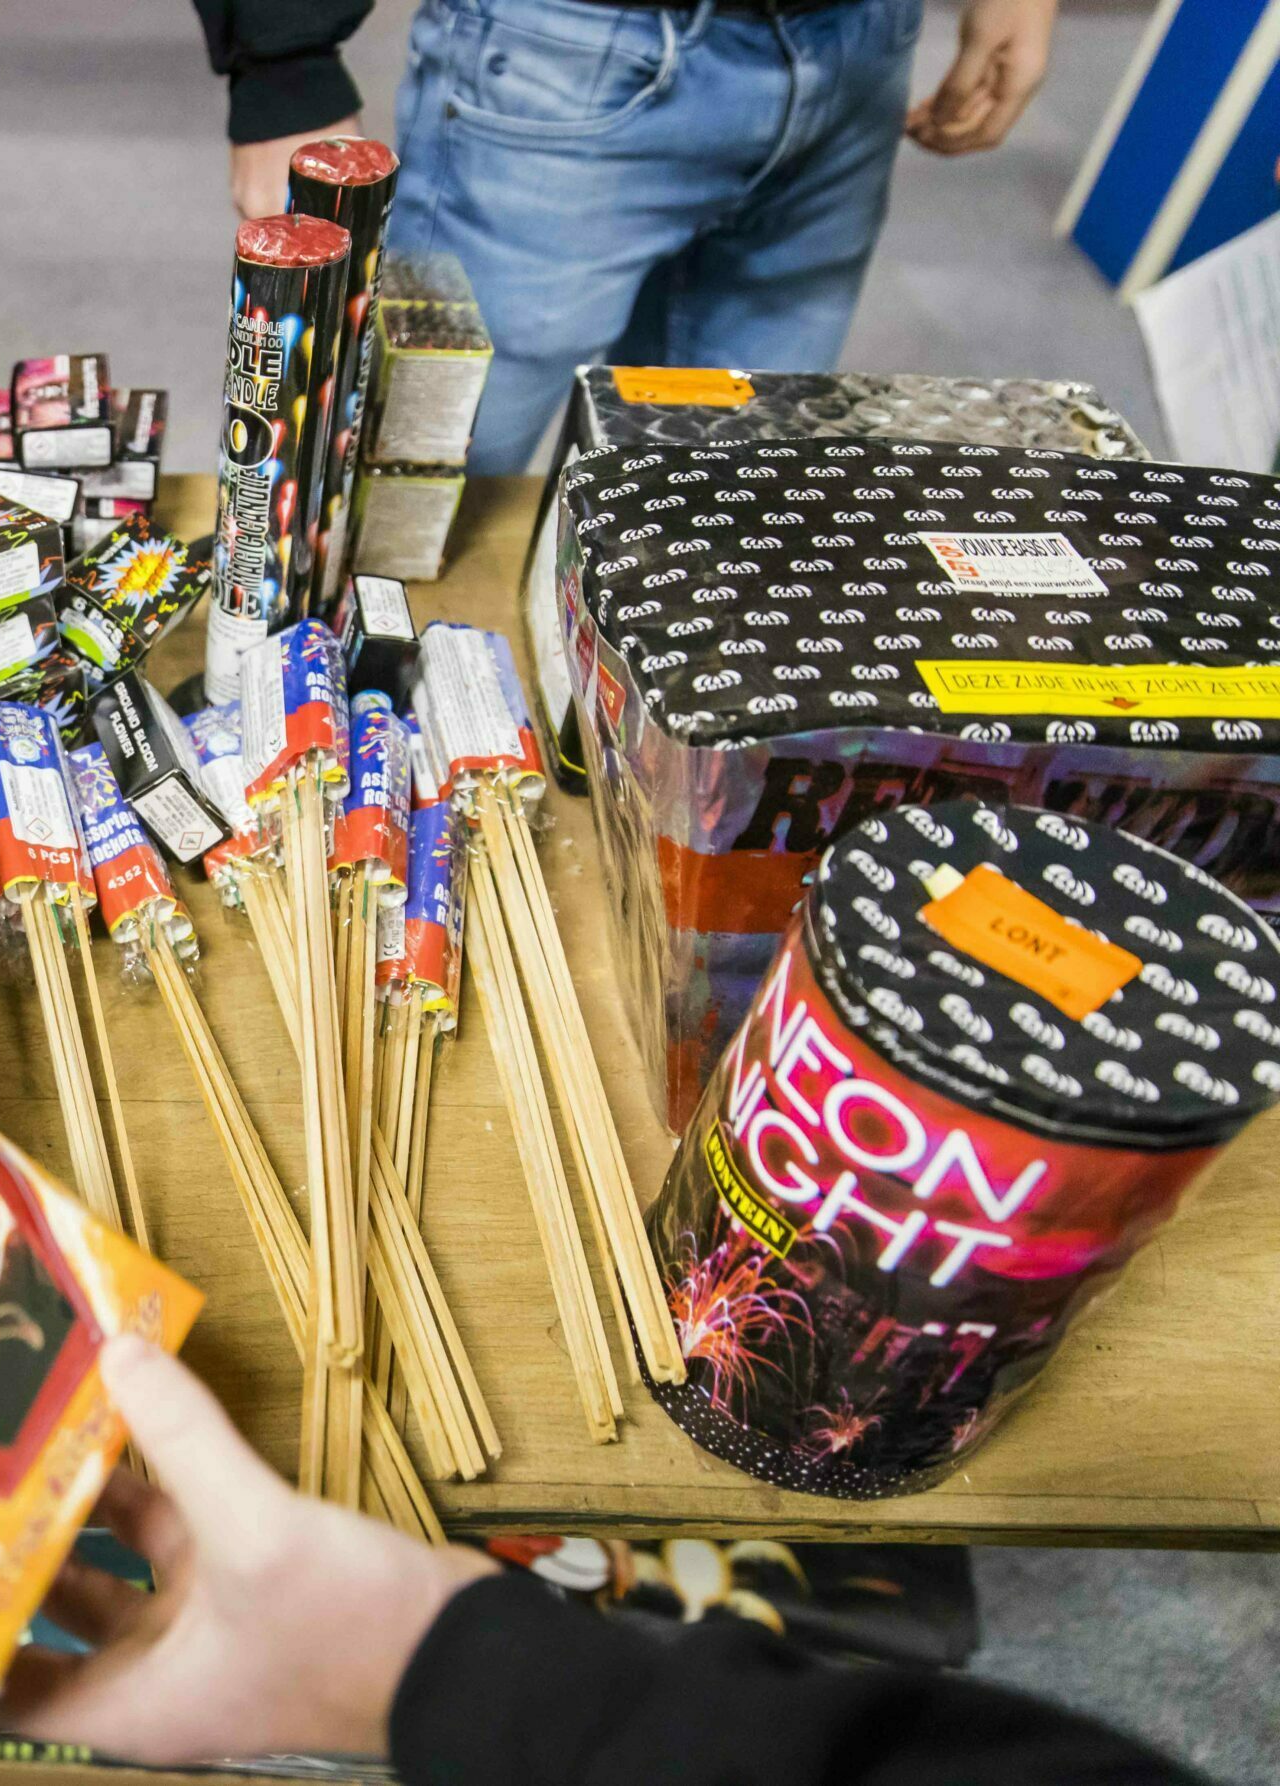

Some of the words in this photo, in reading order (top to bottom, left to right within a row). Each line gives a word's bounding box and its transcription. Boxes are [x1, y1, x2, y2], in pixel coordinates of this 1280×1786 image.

[953, 538, 996, 556] VOUW
[990, 538, 1016, 556] DE
[1010, 538, 1048, 556] BASIS
[958, 578, 988, 588] Draag
[990, 578, 1012, 588] altijd
[1014, 580, 1032, 588] een
[1034, 579, 1093, 588] vuurwerkbril
[72, 596, 88, 612] 6
[88, 608, 124, 649] PCS
[952, 674, 1010, 690] DEZE
[1012, 674, 1068, 691] ZIJDE
[1072, 676, 1094, 691] IN
[1098, 678, 1137, 694] HET
[1142, 678, 1204, 696] ZICHT
[1210, 680, 1280, 698] ZETTEN
[110, 710, 135, 759] FLOWER
[114, 681, 142, 730] GROUND
[133, 728, 159, 773] BLOOM
[28, 848, 36, 860] 6
[40, 848, 71, 864] PCS
[990, 915, 1070, 968] LONT
[758, 950, 1048, 1224] NEON
[727, 1022, 1013, 1289] NIGHT
[707, 1131, 795, 1247] FONTEIN
